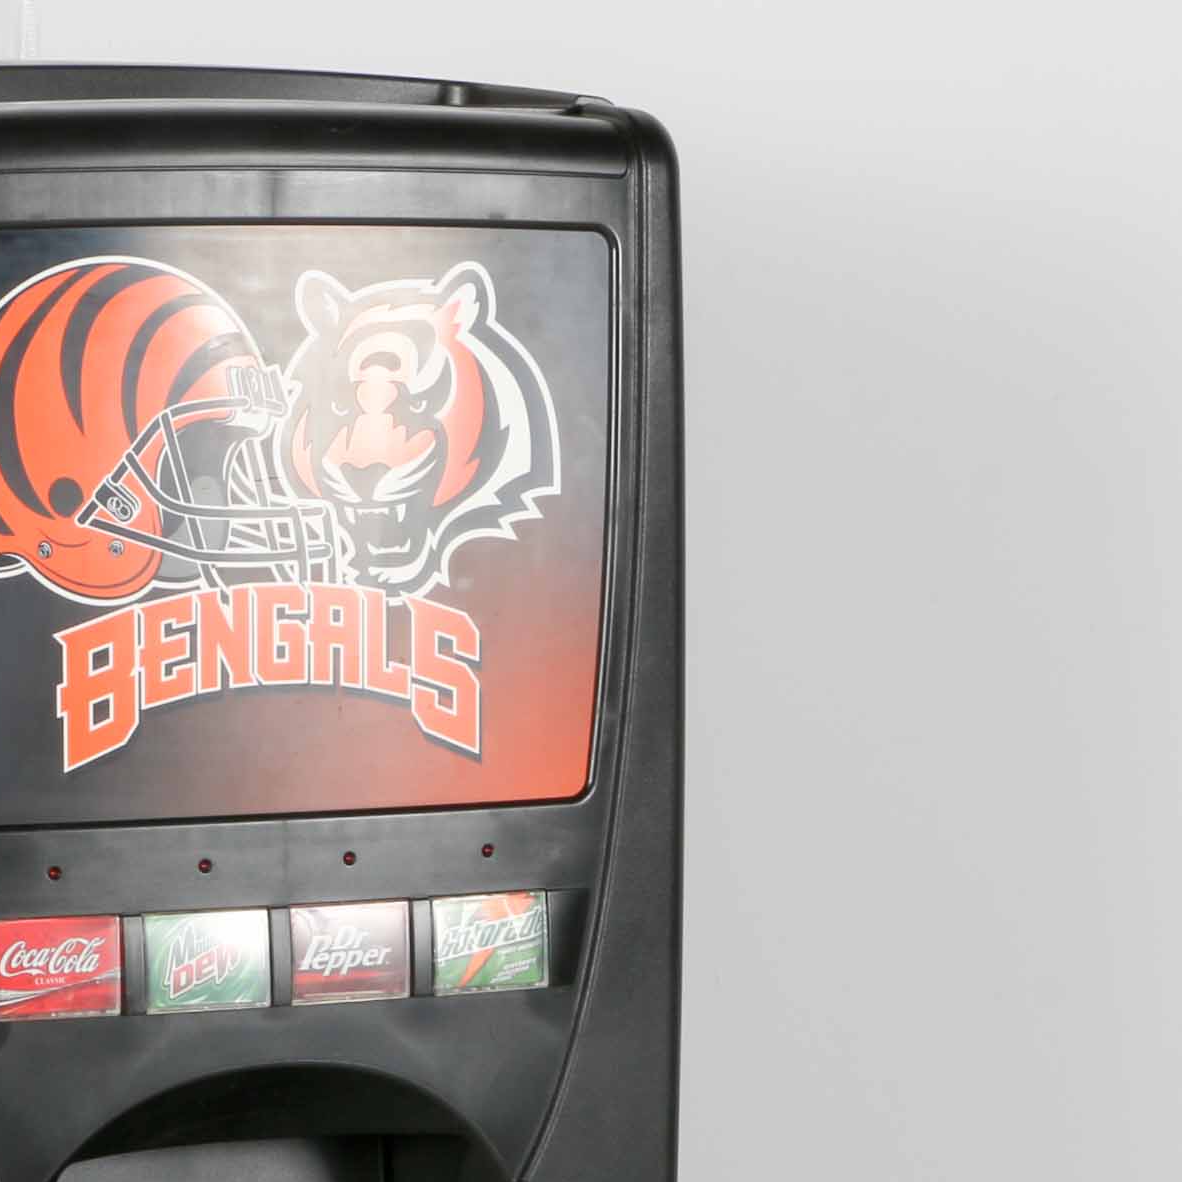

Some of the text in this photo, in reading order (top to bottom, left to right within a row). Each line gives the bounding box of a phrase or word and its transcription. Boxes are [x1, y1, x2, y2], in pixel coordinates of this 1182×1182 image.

[53, 582, 481, 774] BENGALS
[299, 935, 393, 977] Pepper
[331, 925, 371, 951] Dr
